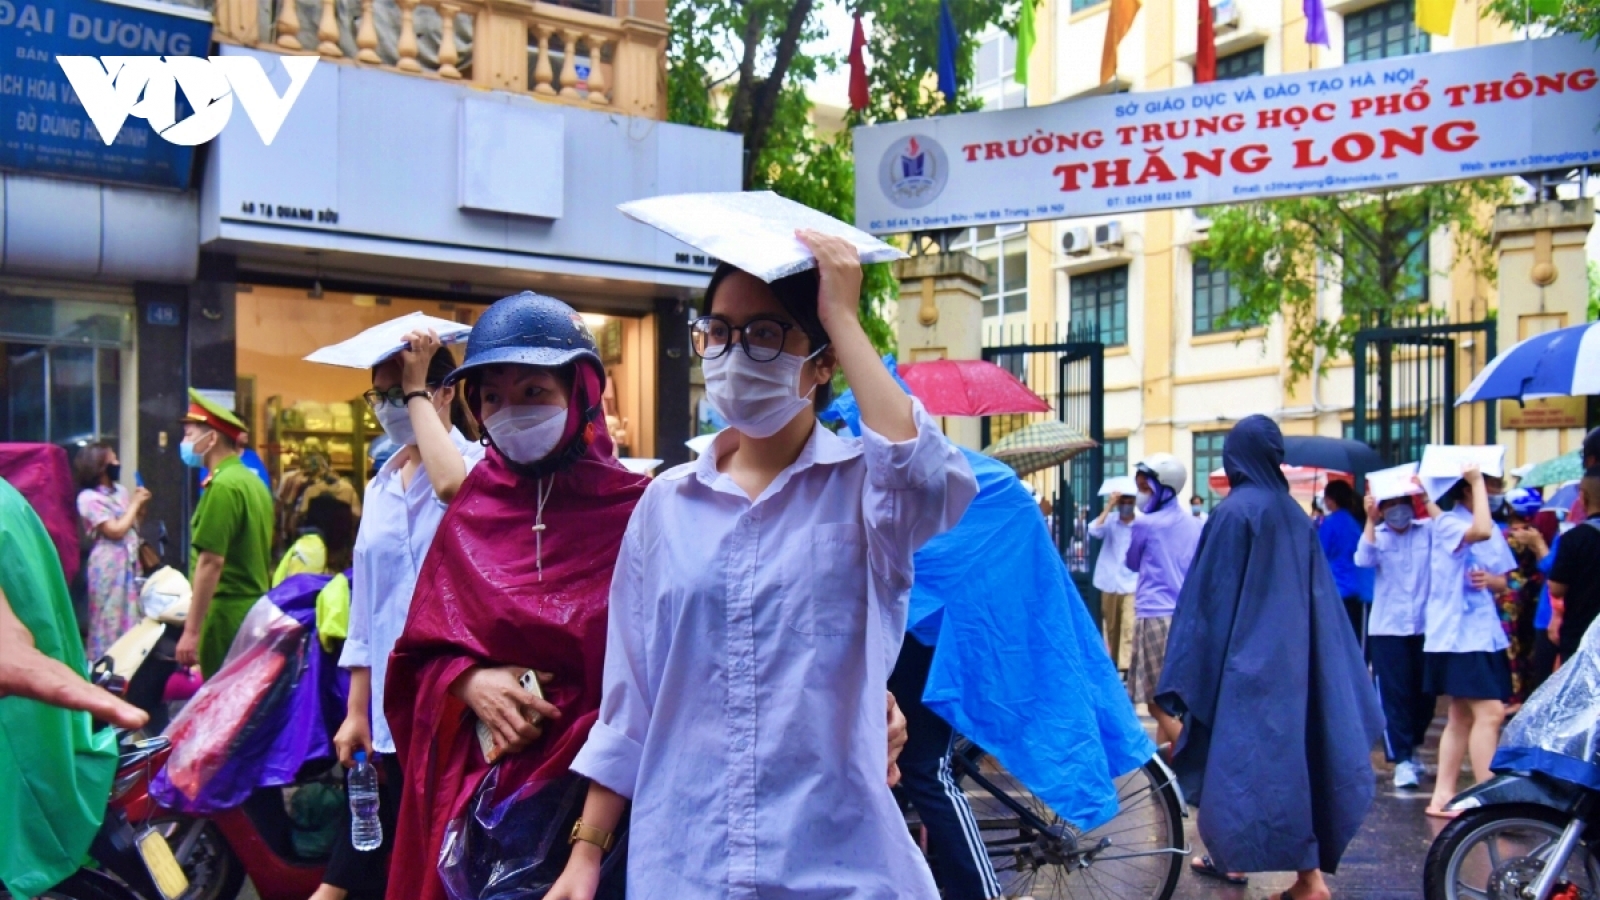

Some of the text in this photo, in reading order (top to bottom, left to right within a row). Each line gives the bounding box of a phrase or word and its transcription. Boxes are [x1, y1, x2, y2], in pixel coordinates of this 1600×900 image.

[68, 12, 191, 56] DƯƠNG
[962, 68, 1599, 162] TRƯỜNG TRUNG HỌC PHỔ THÔNG
[1115, 68, 1415, 117] SỞ GIÁO DỤC VÀ ĐÀO TẠO HÀ NỘI
[1053, 119, 1480, 192] THĂNG LONG
